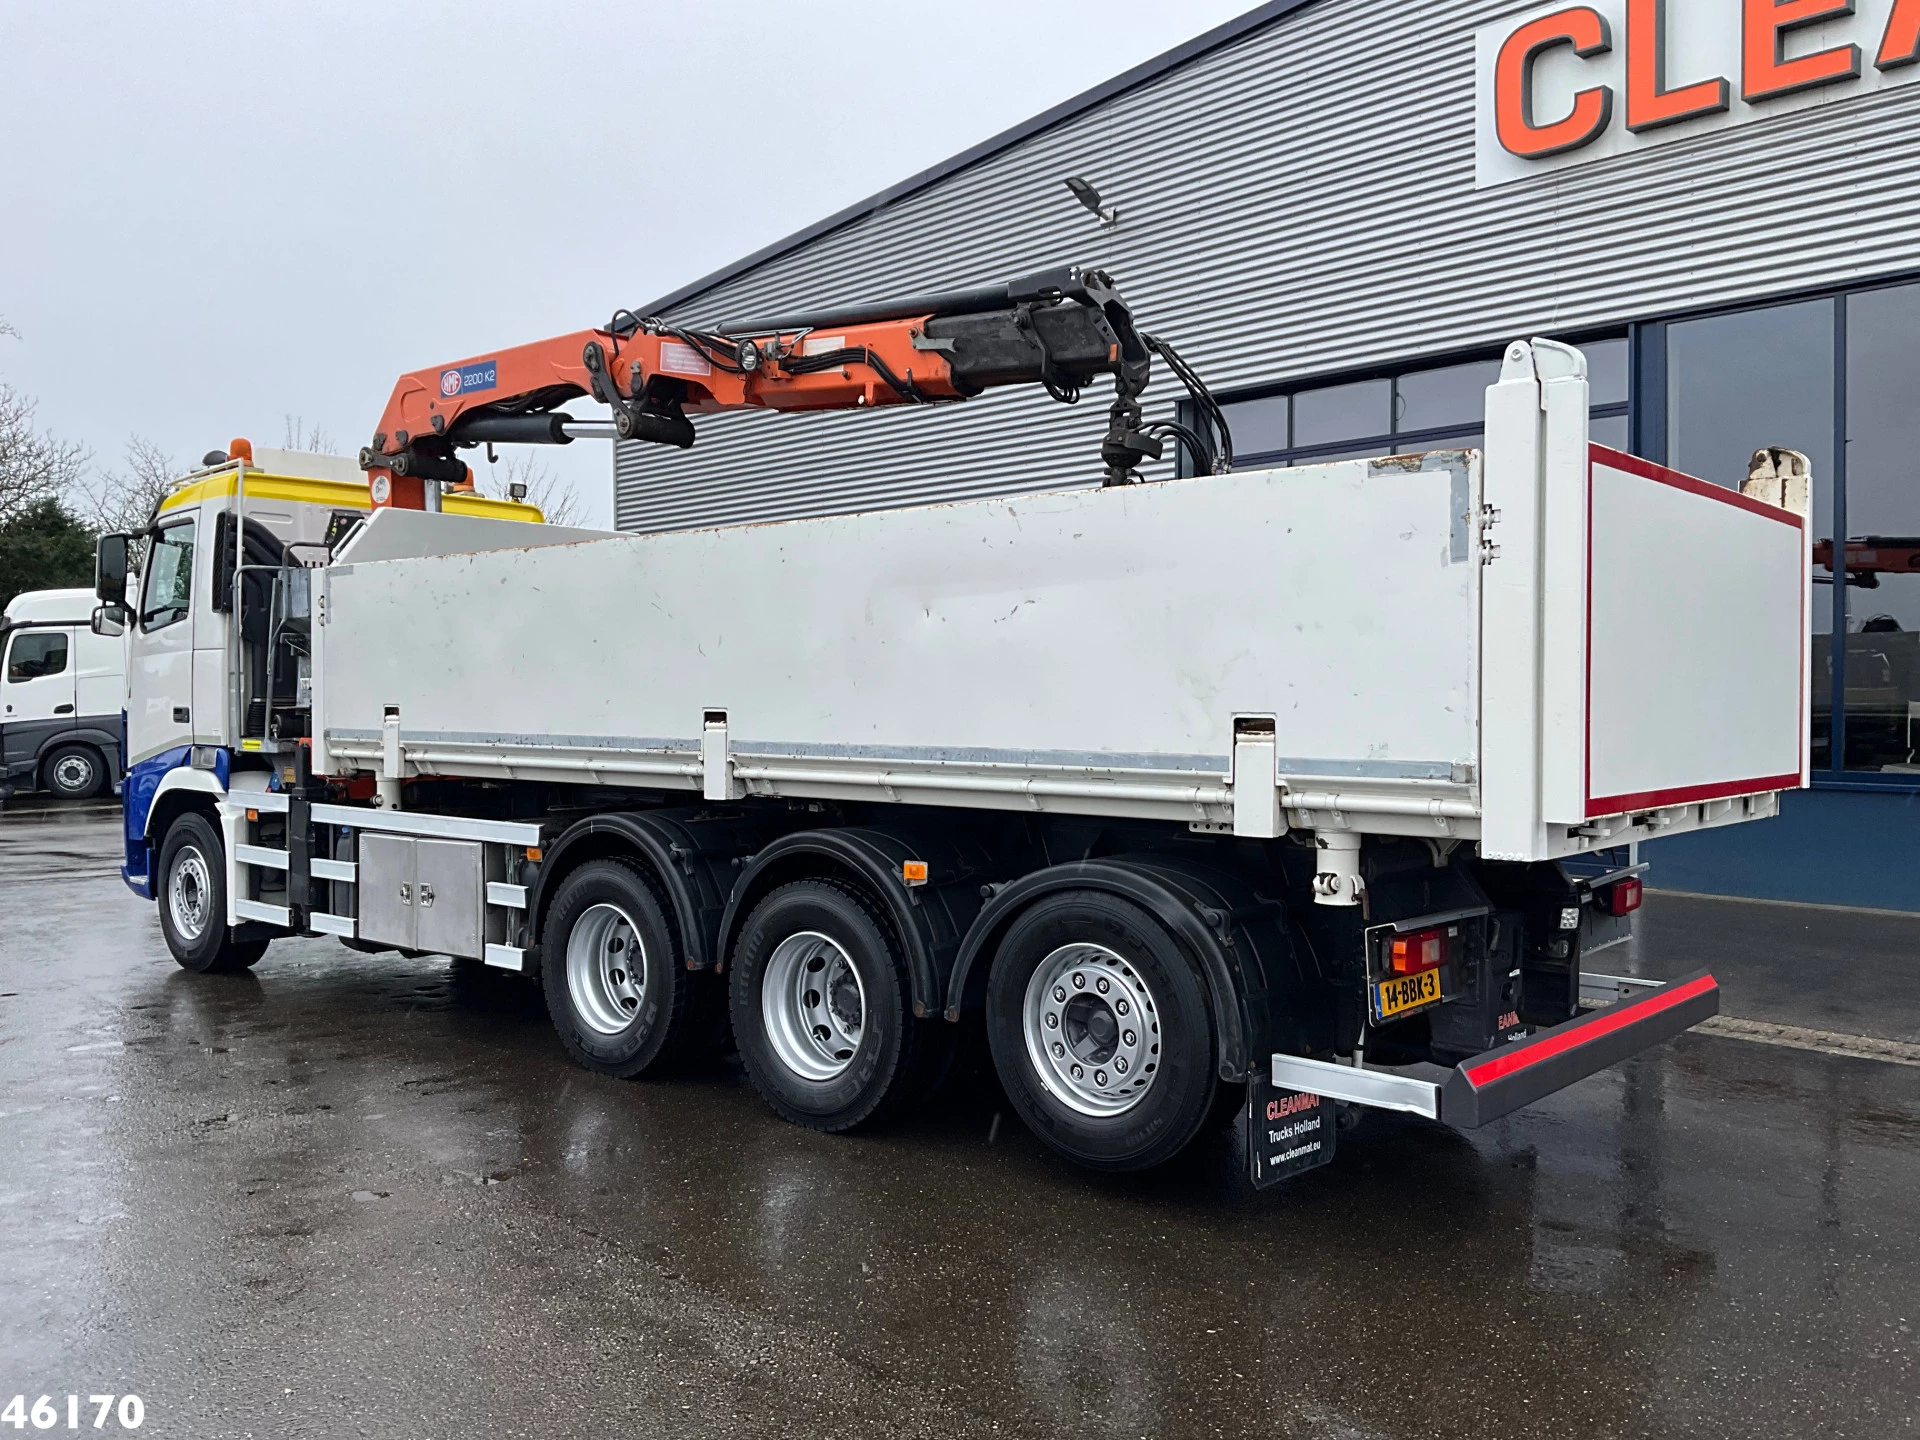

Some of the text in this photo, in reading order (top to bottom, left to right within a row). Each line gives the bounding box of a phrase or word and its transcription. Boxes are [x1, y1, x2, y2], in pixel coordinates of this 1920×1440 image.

[1494, 0, 1920, 160] CLE
[442, 369, 495, 394] HMF 2200 K2
[1385, 973, 1435, 1010] 14-BBK-3
[1268, 1116, 1320, 1143] Trucks Holland
[1270, 1141, 1320, 1165] www.cleanmat.eu
